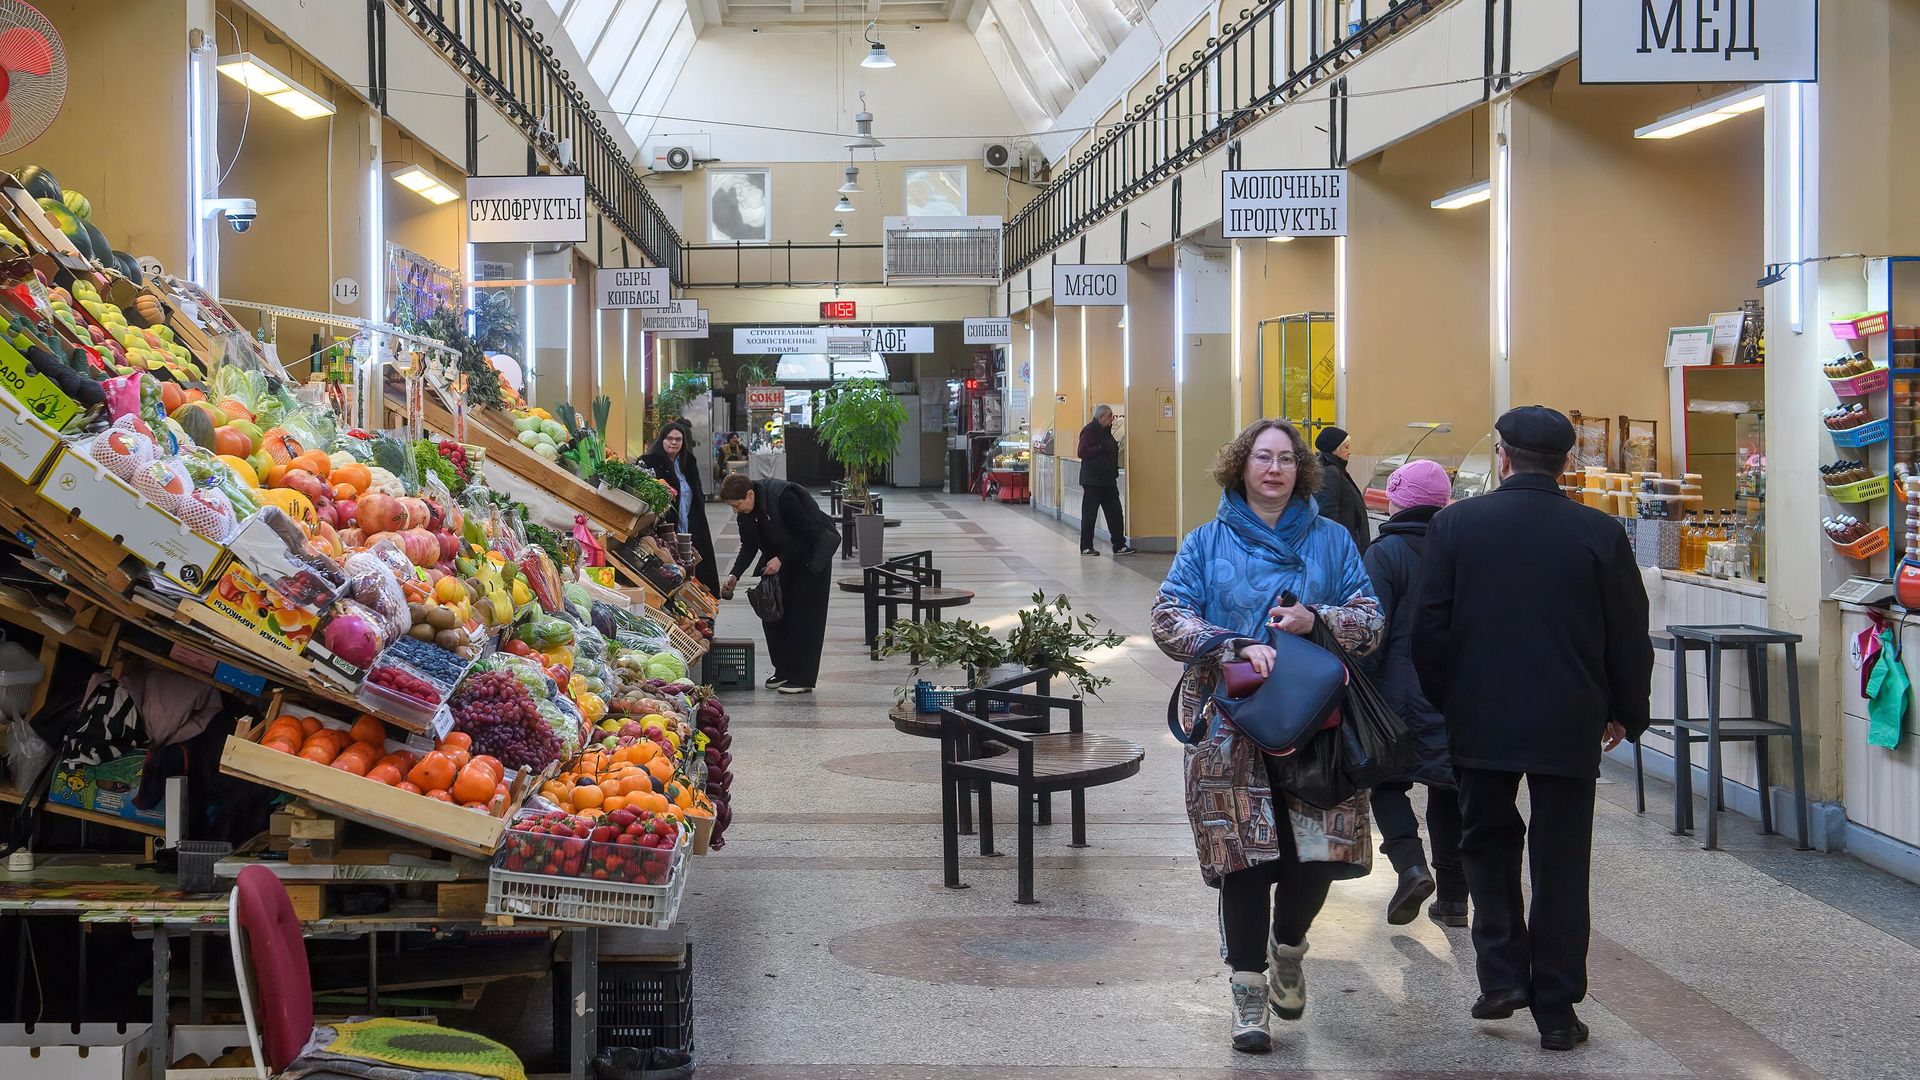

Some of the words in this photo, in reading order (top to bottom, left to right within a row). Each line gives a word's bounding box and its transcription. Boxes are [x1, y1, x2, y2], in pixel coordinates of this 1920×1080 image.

[1636, 0, 1760, 61] МЕД
[1229, 174, 1340, 200] МОЛОЧНЫЕ
[470, 198, 582, 222] СУХОФРУКТЫ
[1229, 206, 1338, 235] ПРОДУКТЫ
[334, 283, 359, 298] 114
[615, 271, 651, 287] СЫРЫ
[1064, 273, 1118, 297] МЯСО
[607, 290, 660, 306] КОЛБАСЫ
[642, 316, 697, 329] МОРЕПРОДУКТЫ
[967, 324, 1008, 337] СОЛЕНЬЯ
[861, 328, 907, 352] КАФЕ
[749, 392, 781, 403] СОКИ
[213, 599, 257, 630] АБРИКОСЫ
